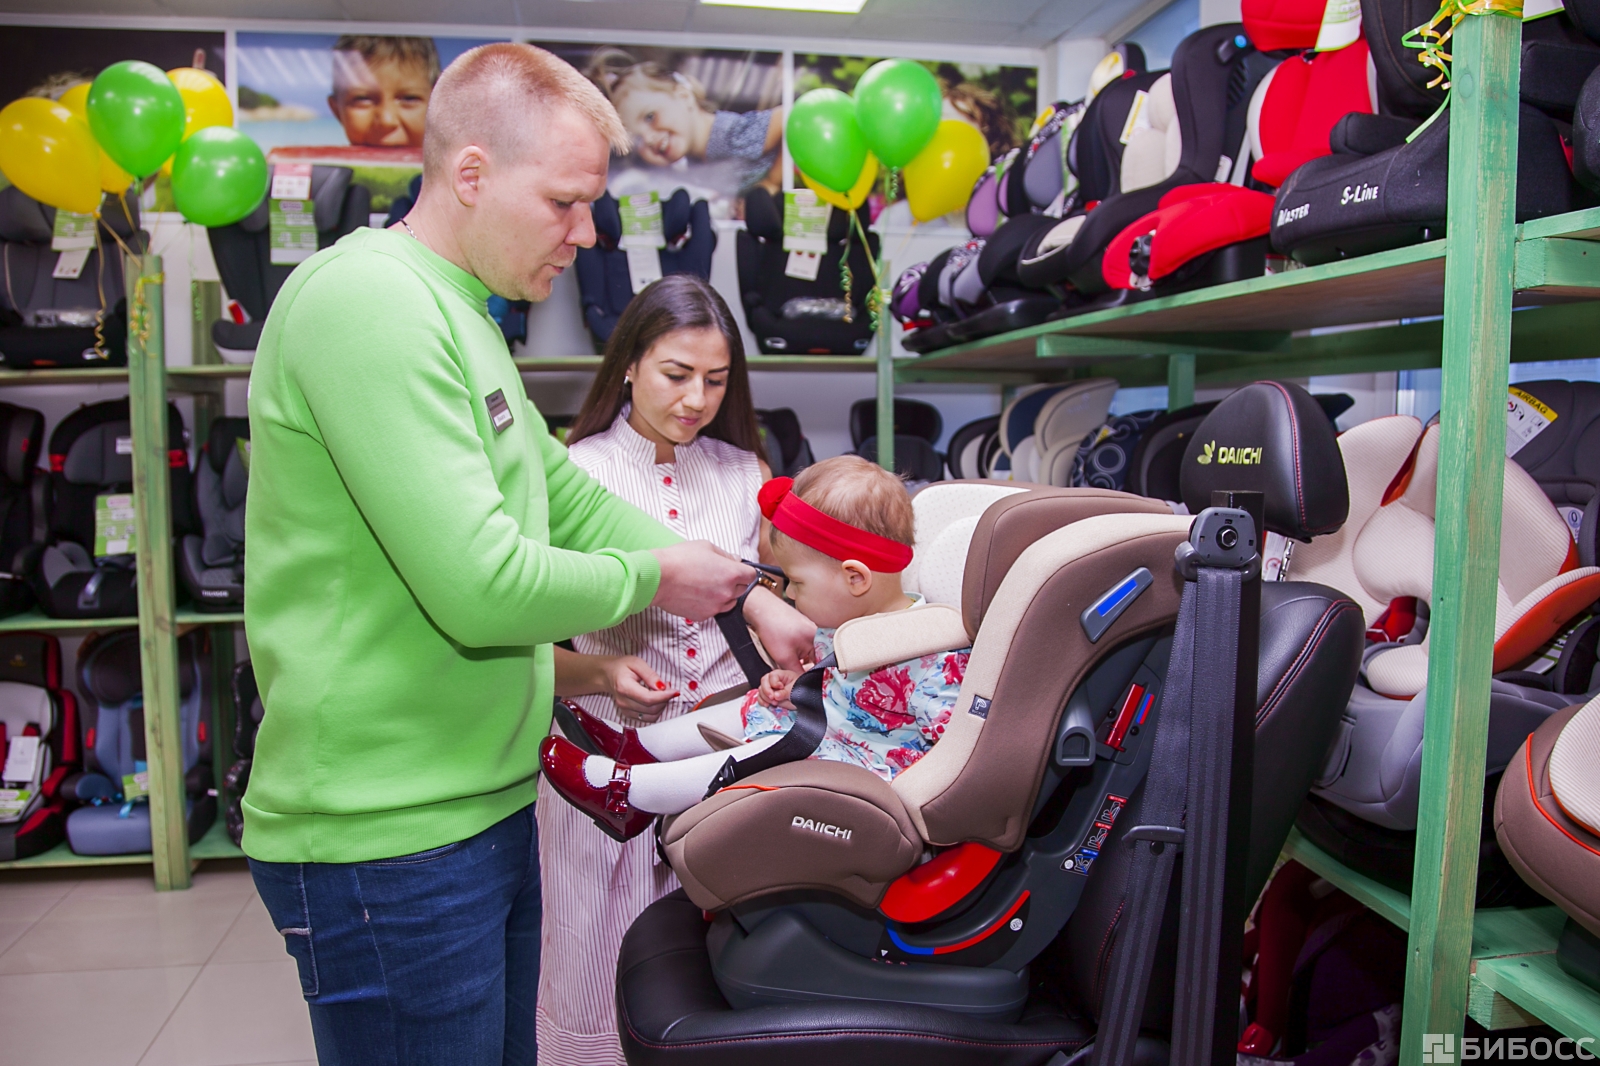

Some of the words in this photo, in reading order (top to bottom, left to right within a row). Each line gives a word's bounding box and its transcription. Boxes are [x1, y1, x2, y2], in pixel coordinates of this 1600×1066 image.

[1515, 390, 1549, 414] AIRBAG
[1217, 446, 1263, 465] DAIICHI
[791, 815, 853, 840] DAIICHI
